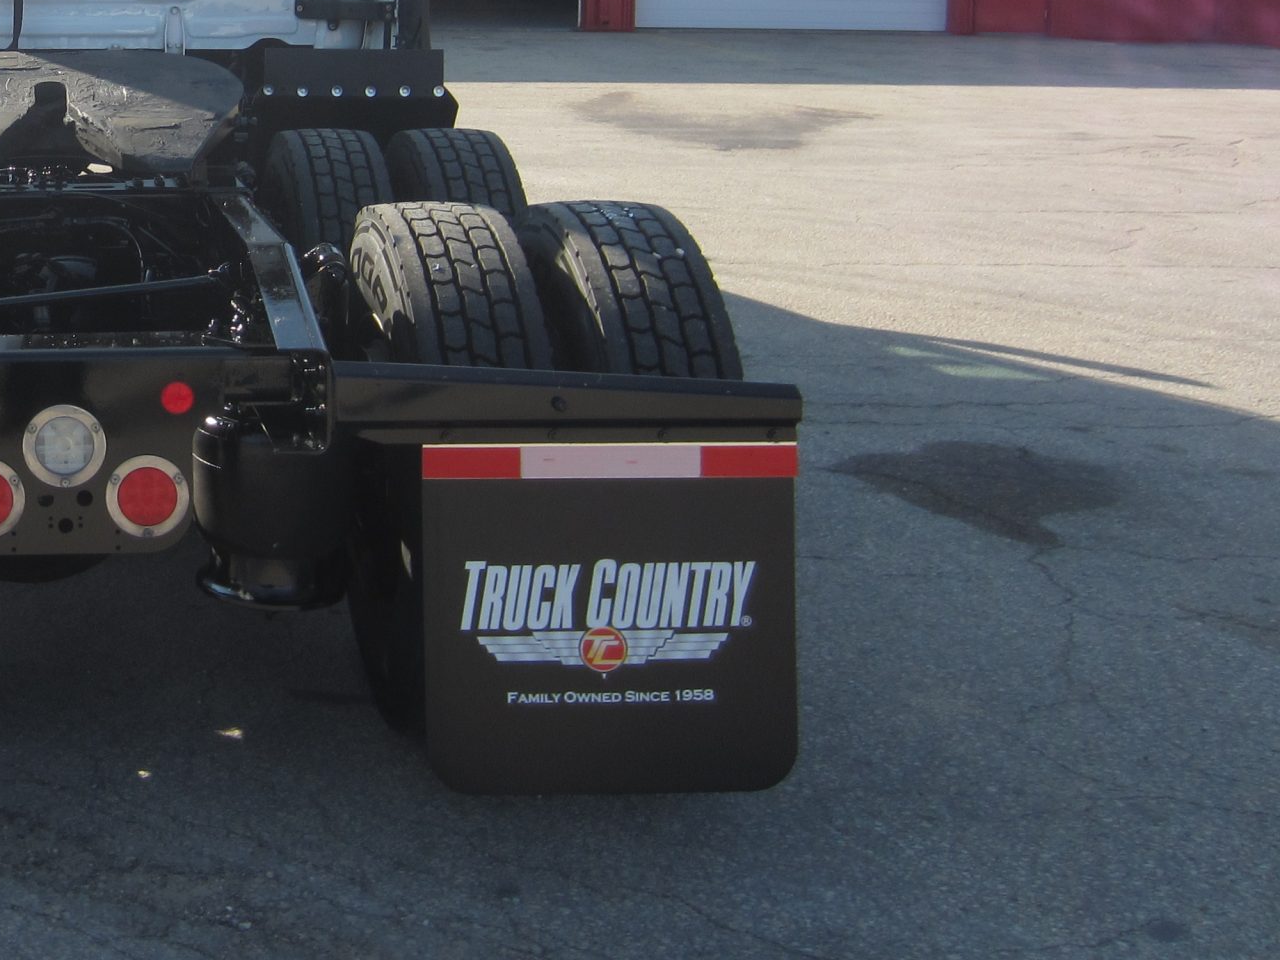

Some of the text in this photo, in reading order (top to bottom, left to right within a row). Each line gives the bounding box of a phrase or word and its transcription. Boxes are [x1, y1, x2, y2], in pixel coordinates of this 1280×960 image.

[461, 558, 756, 631] TRUCK COUNTRY
[507, 688, 715, 704] FAMILY OWNED SINCE 1958
